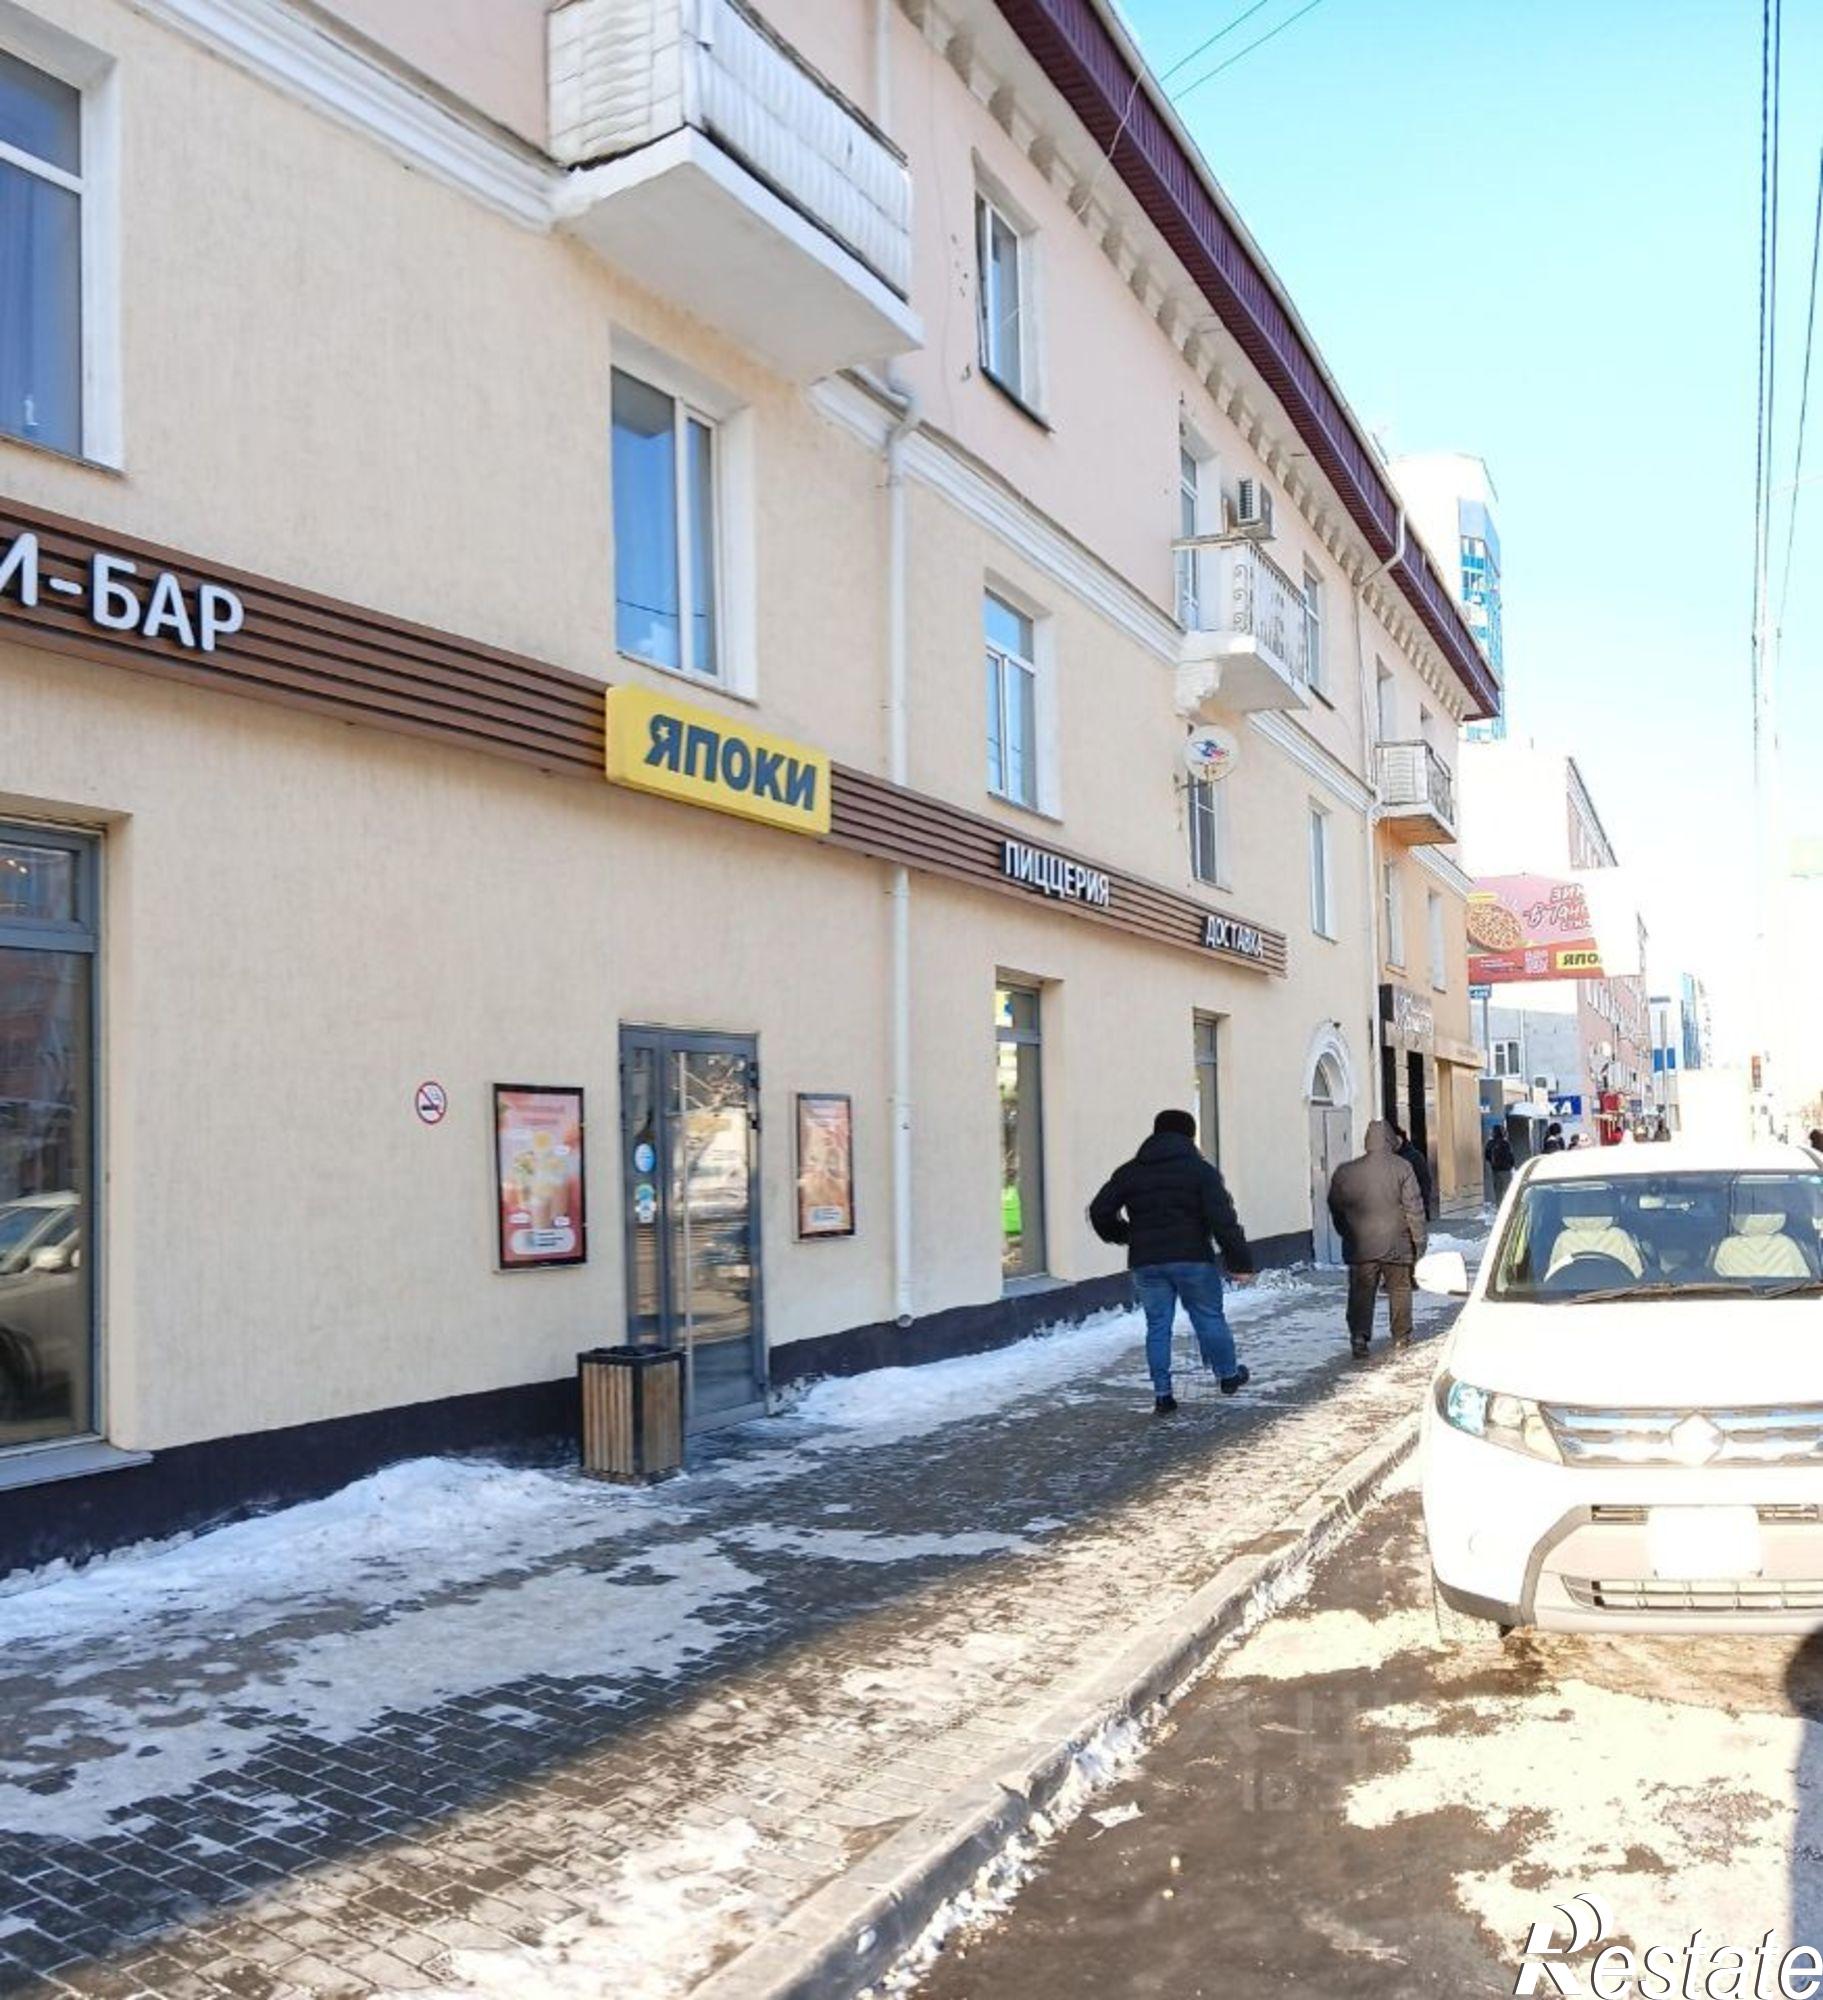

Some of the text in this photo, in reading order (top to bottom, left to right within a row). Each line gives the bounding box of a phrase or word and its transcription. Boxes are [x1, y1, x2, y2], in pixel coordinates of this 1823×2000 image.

[643, 713, 817, 811] ЯПОКИ
[1003, 840, 1111, 908] ПИЦЦЕРИЯ
[1204, 915, 1265, 958] ДОСТАВКА
[1563, 952, 1602, 966] ЯПО
